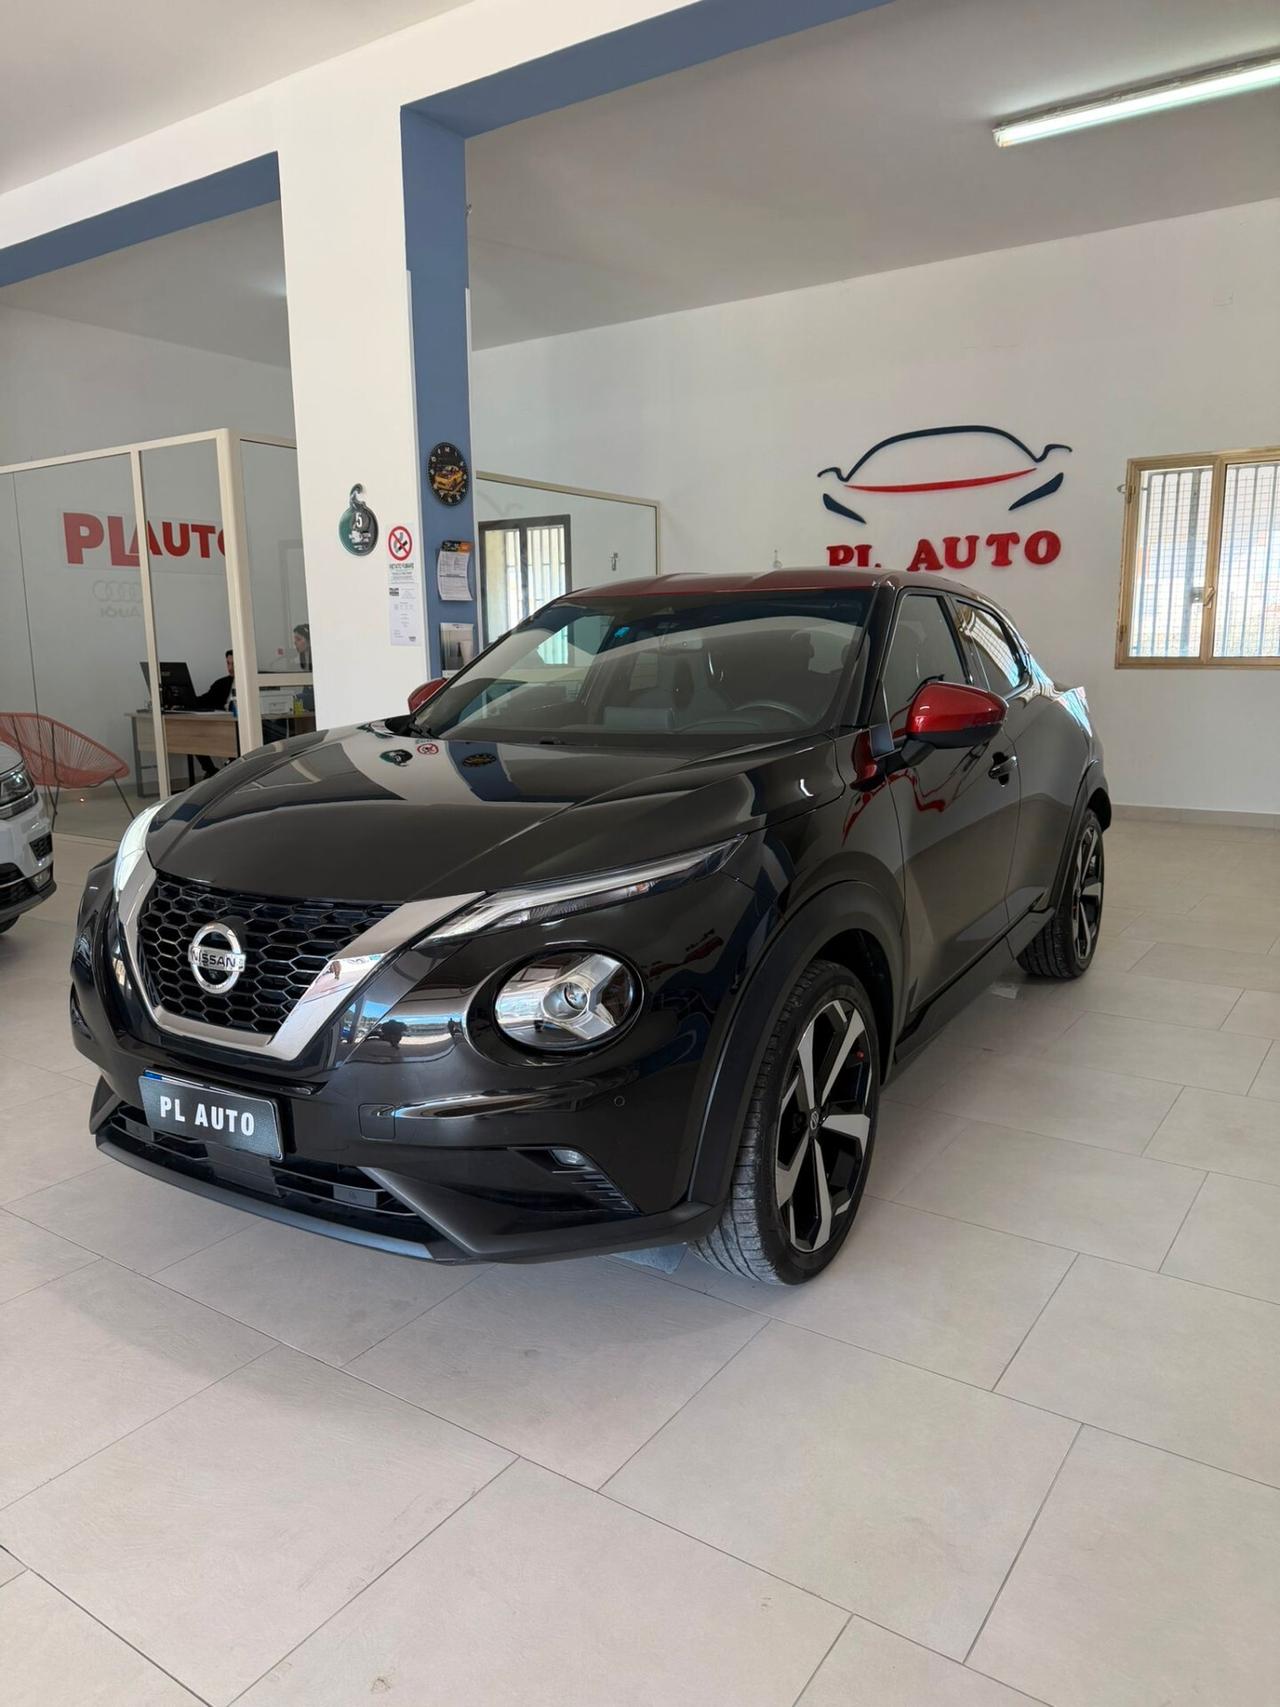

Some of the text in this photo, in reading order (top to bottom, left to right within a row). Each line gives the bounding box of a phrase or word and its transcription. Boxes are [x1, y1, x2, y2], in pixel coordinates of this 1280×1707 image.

[129, 519, 225, 558] AUT
[355, 512, 363, 528] 5
[907, 530, 1061, 571] AUTO
[191, 947, 236, 968] NISSAN
[160, 1096, 255, 1136] PL AUTO
